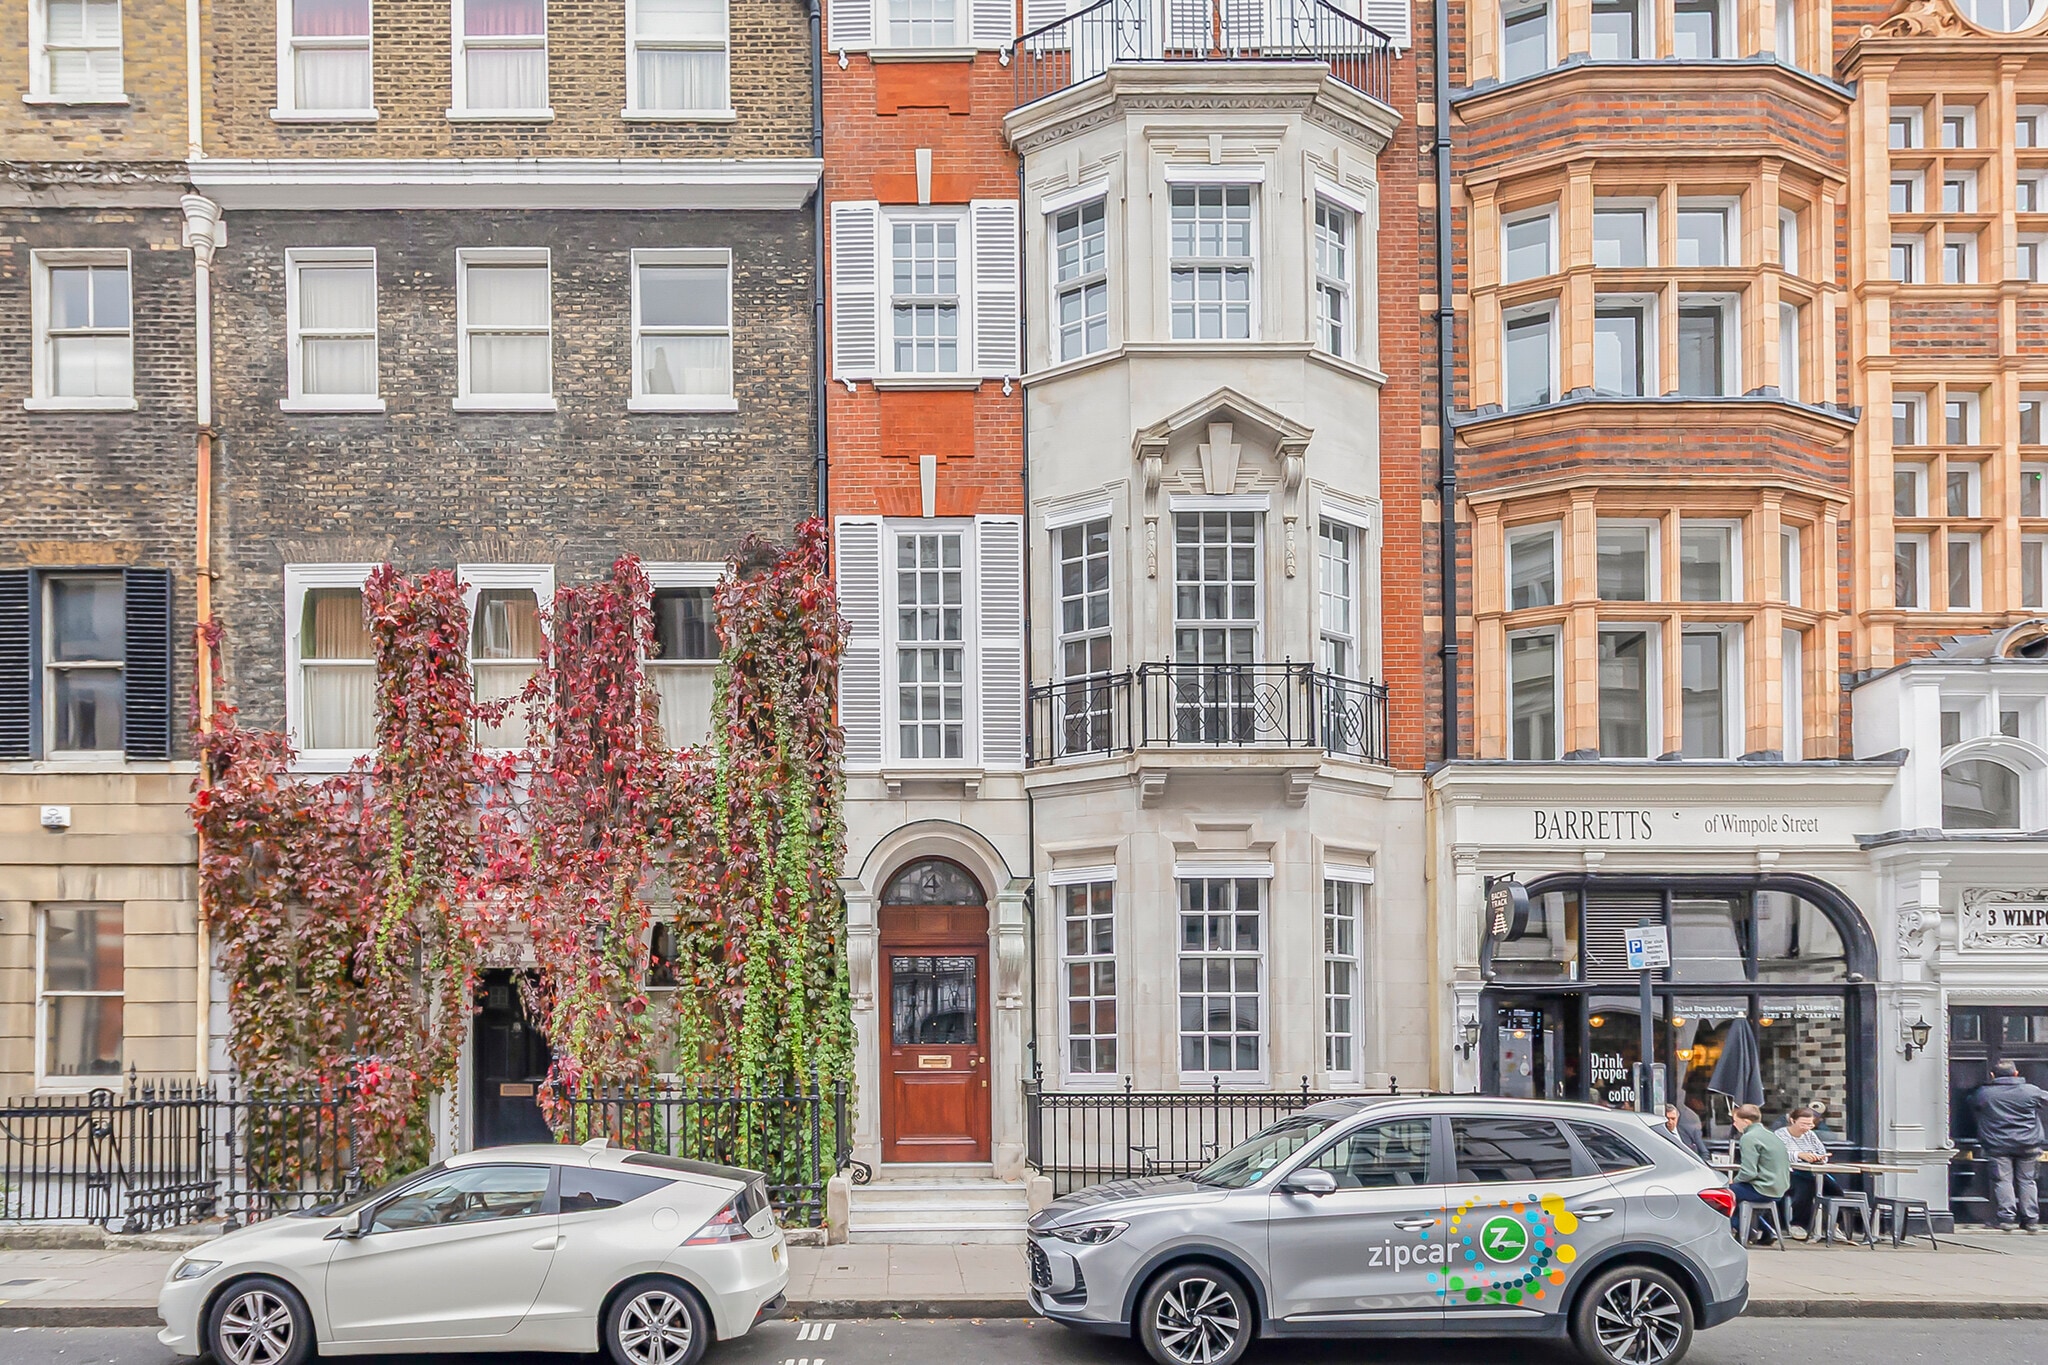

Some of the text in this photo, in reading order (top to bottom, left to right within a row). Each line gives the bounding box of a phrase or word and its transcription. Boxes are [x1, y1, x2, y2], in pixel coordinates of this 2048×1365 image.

[1534, 810, 1819, 840] BARRETTS of Wimpole Street
[1491, 898, 1507, 908] TRACK
[1988, 909, 2048, 926] 3 WIMP
[1631, 941, 1641, 953] P
[1590, 1052, 1624, 1069] Drink
[1591, 1068, 1629, 1084] proper
[1608, 1086, 1635, 1102] coffe
[1368, 1239, 1461, 1273] zipcar
